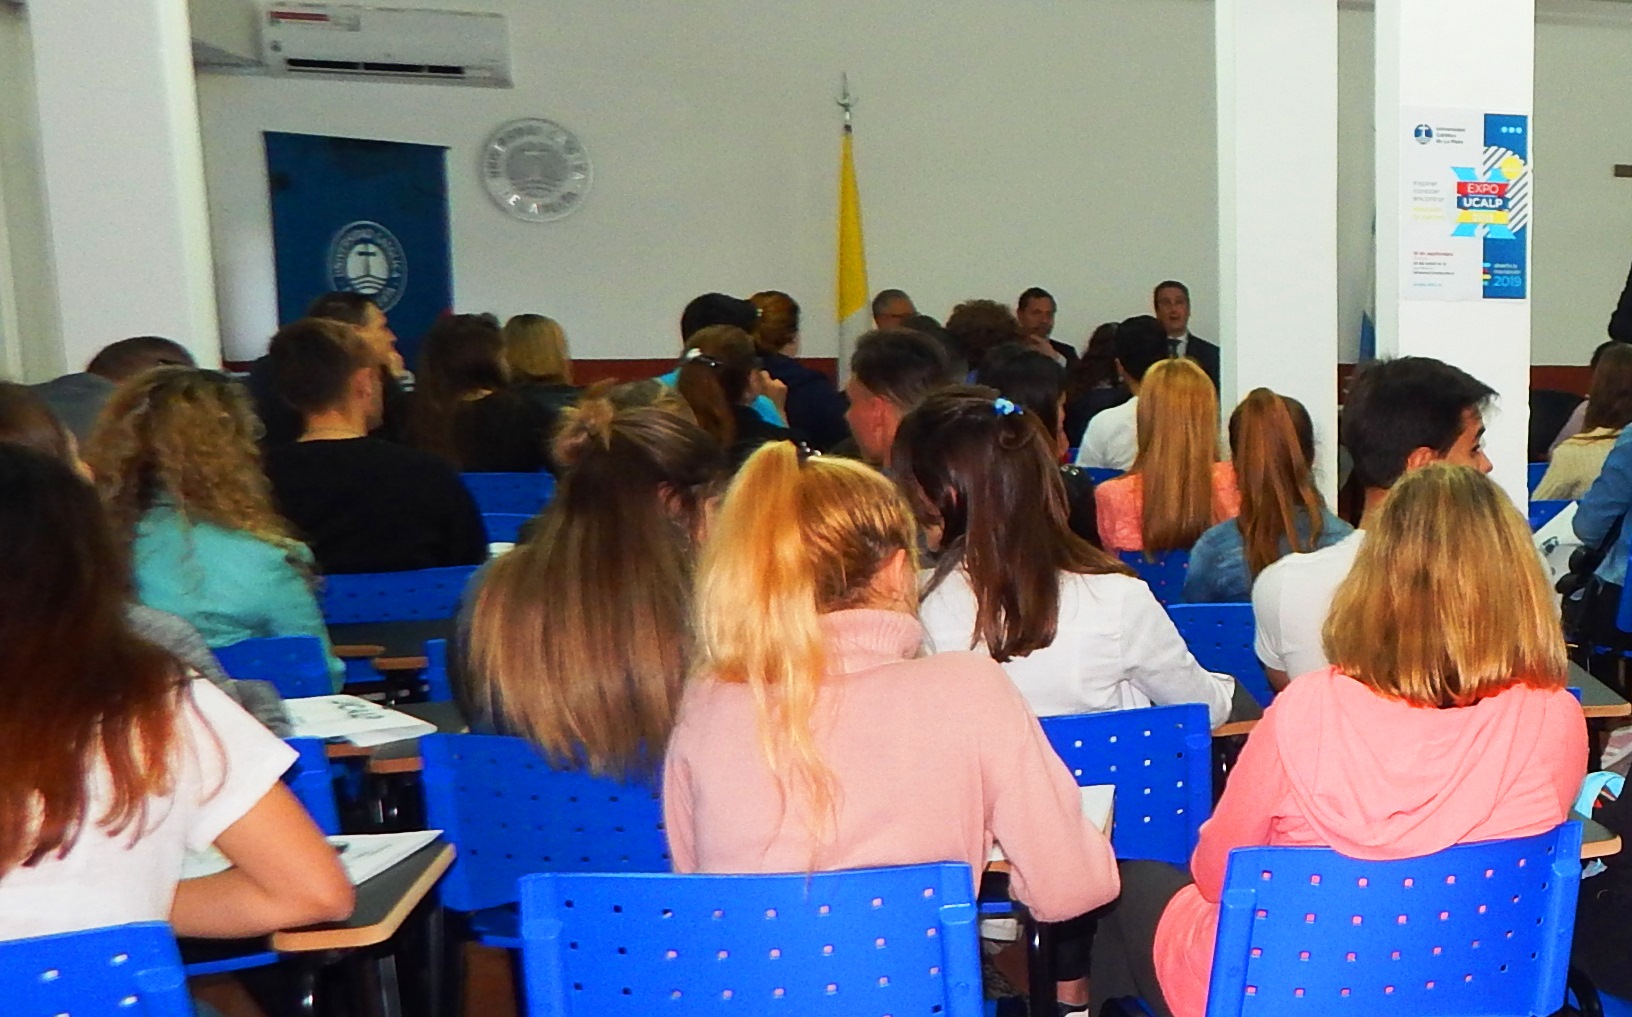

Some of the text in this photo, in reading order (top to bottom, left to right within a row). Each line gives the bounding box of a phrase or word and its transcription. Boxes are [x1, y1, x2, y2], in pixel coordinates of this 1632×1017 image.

[1467, 183, 1499, 193] EXPO
[1463, 198, 1503, 208] UCALP
[1493, 276, 1522, 287] 2019
